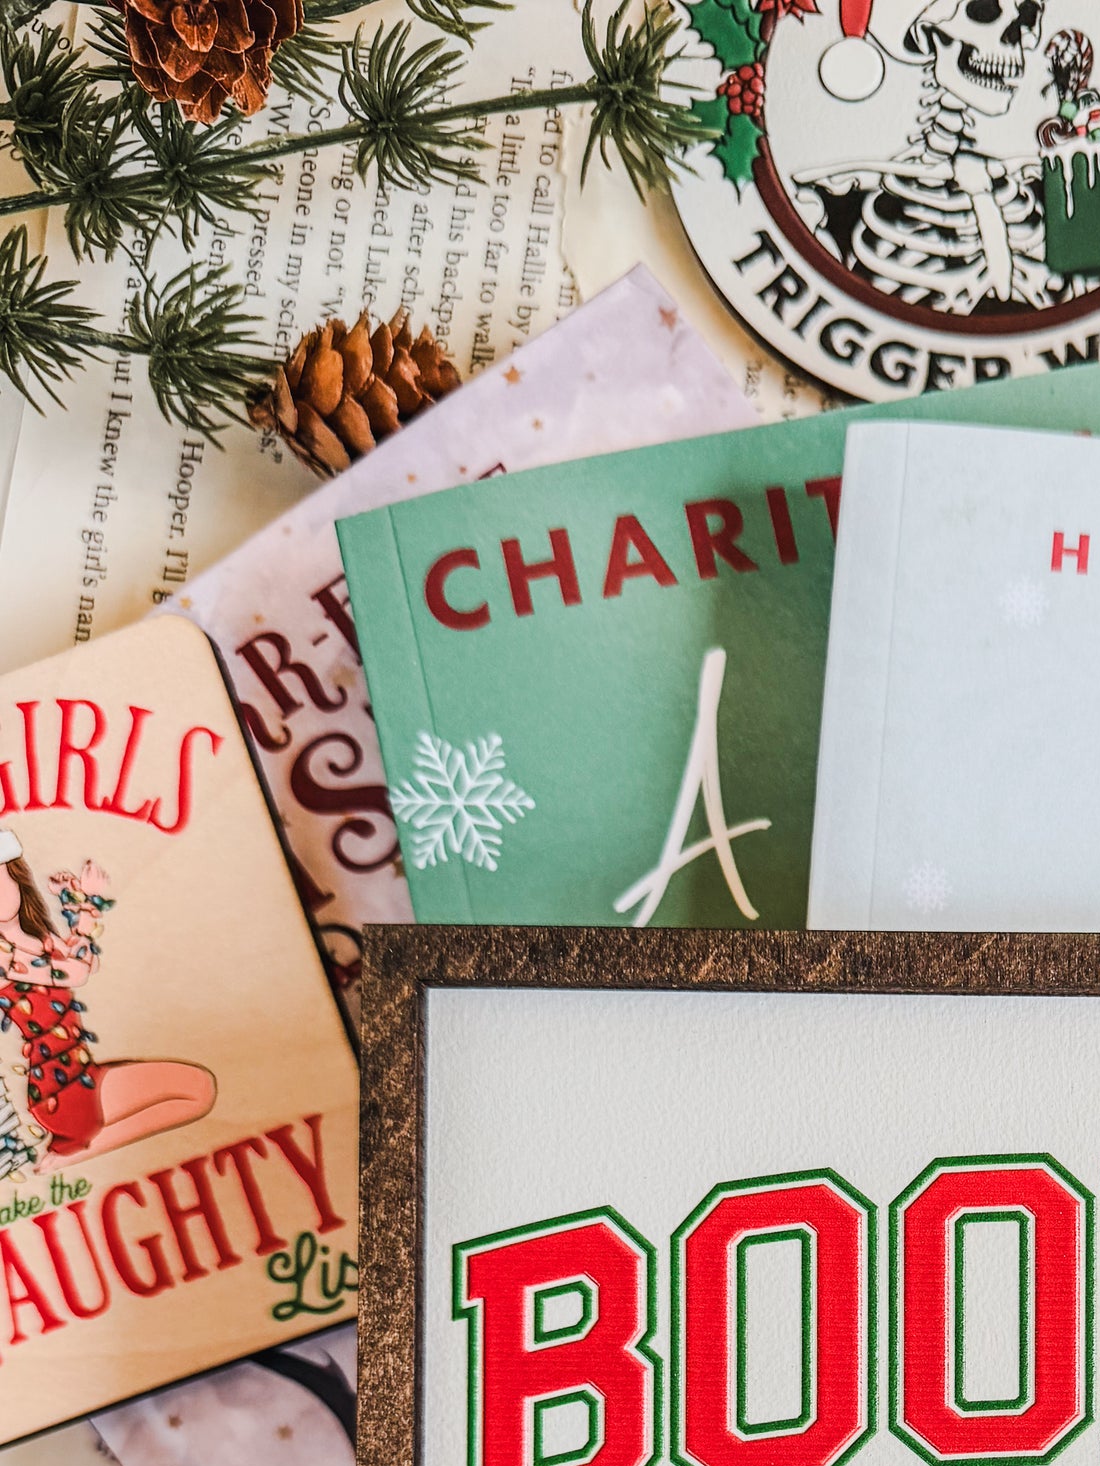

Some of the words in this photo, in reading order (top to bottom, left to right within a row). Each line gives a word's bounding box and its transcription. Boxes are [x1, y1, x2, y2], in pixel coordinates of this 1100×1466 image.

[496, 133, 525, 187] little
[539, 147, 555, 166] to
[334, 199, 350, 224] or
[489, 194, 513, 231] too
[532, 174, 555, 215] call
[292, 226, 314, 246] in
[409, 204, 433, 257] after
[448, 207, 474, 241] his
[277, 254, 303, 294] my
[485, 241, 510, 274] far
[519, 225, 550, 297] Hallie
[480, 282, 499, 304] to
[507, 302, 539, 335] by
[101, 408, 131, 478] knew
[93, 485, 117, 523] the
